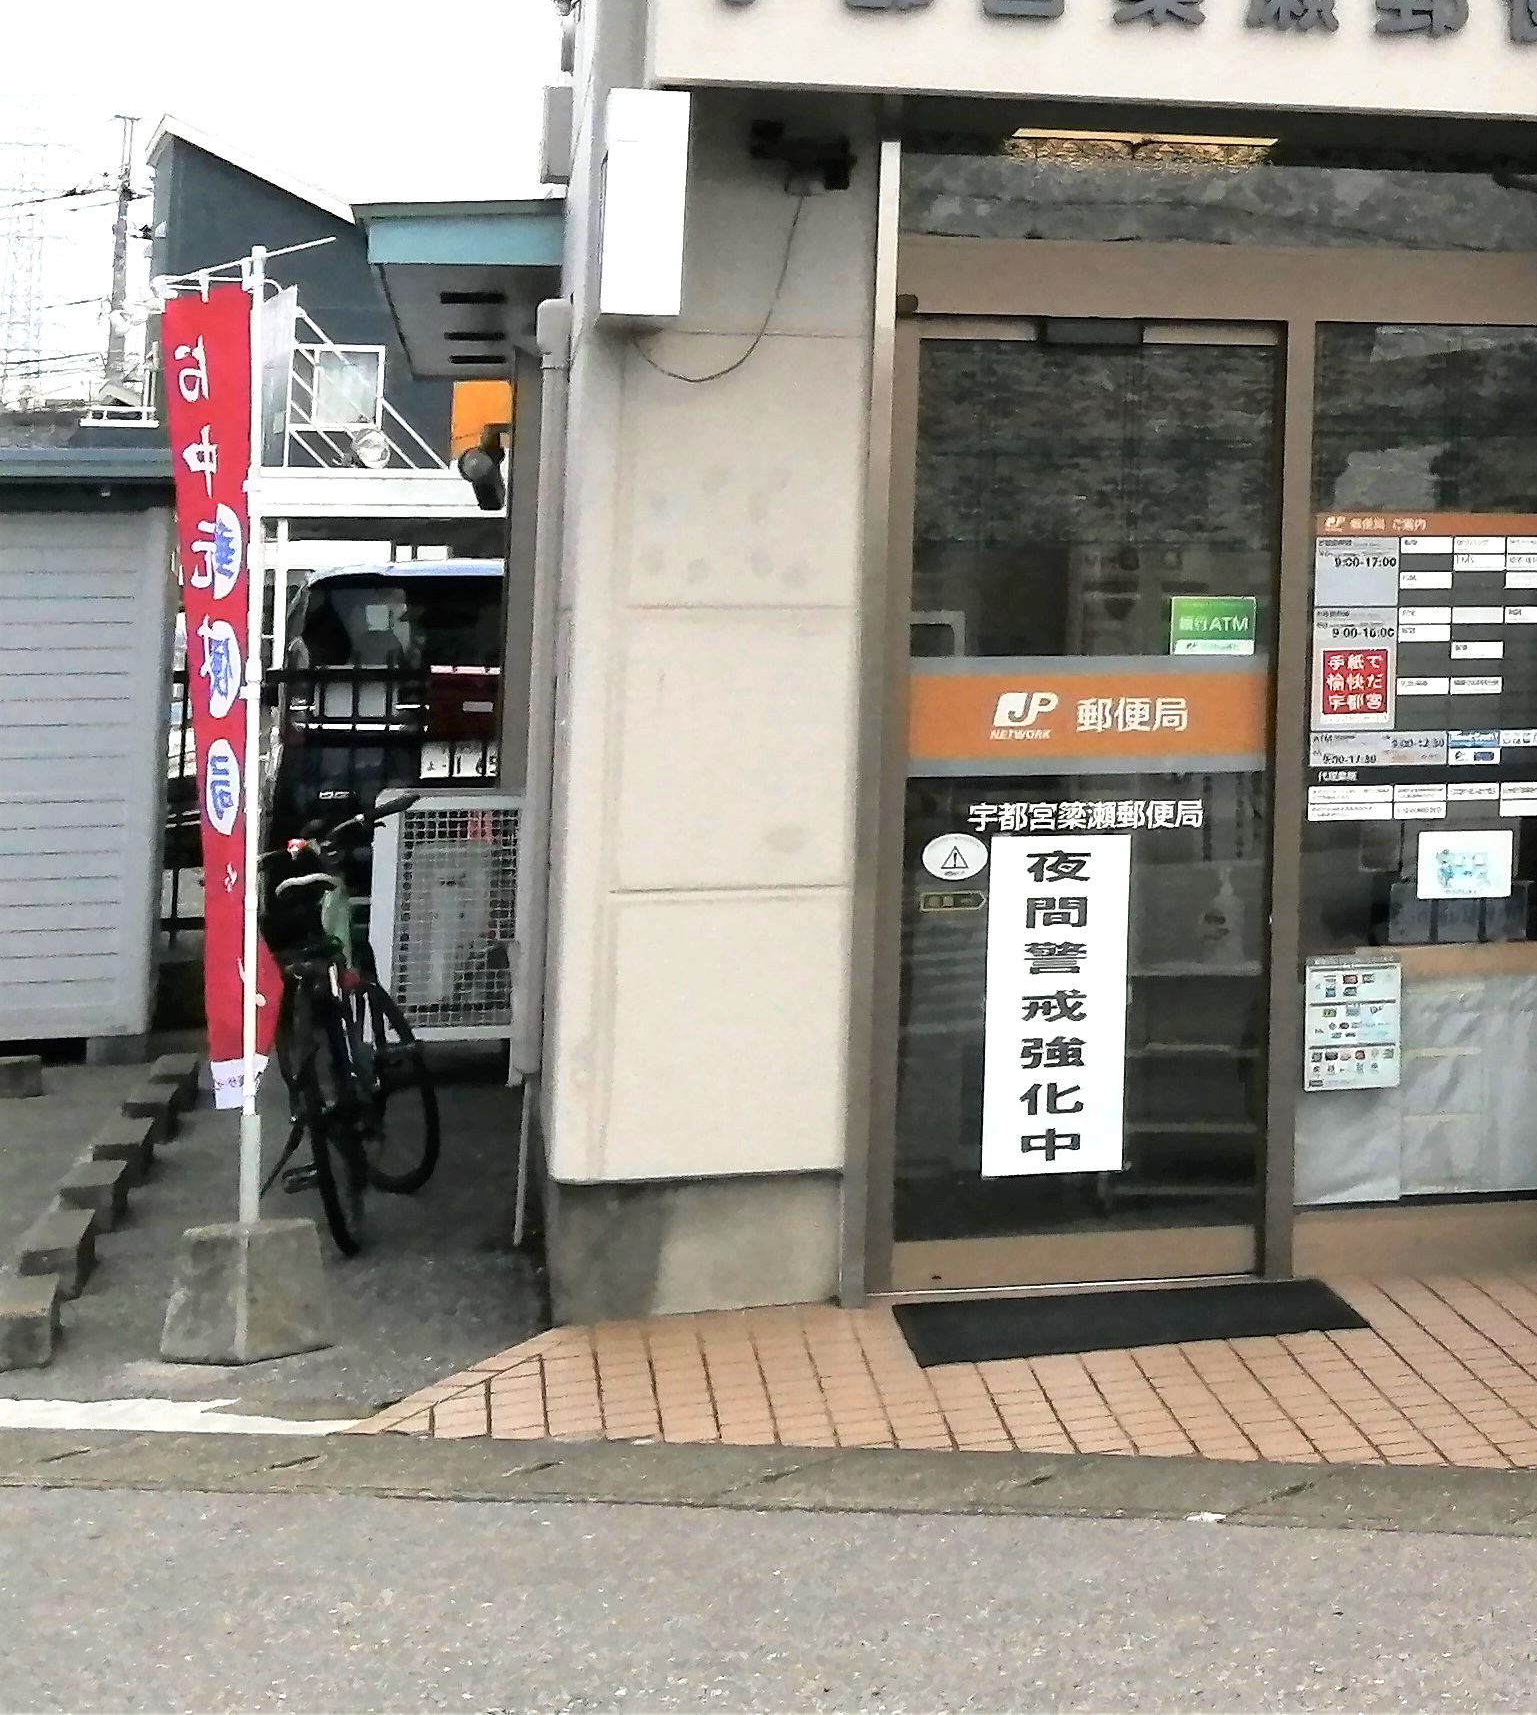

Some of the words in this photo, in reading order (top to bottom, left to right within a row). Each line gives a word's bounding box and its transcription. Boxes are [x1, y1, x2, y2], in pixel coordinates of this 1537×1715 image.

[1335, 556, 1397, 568] 9:00-17:00
[1327, 654, 1383, 671] 手紙で
[1326, 673, 1384, 691] 愉快だ
[1075, 697, 1189, 733] 郵便局
[989, 729, 1052, 741] NETWORK
[1019, 848, 1092, 1164] 夜間警戒強化中
